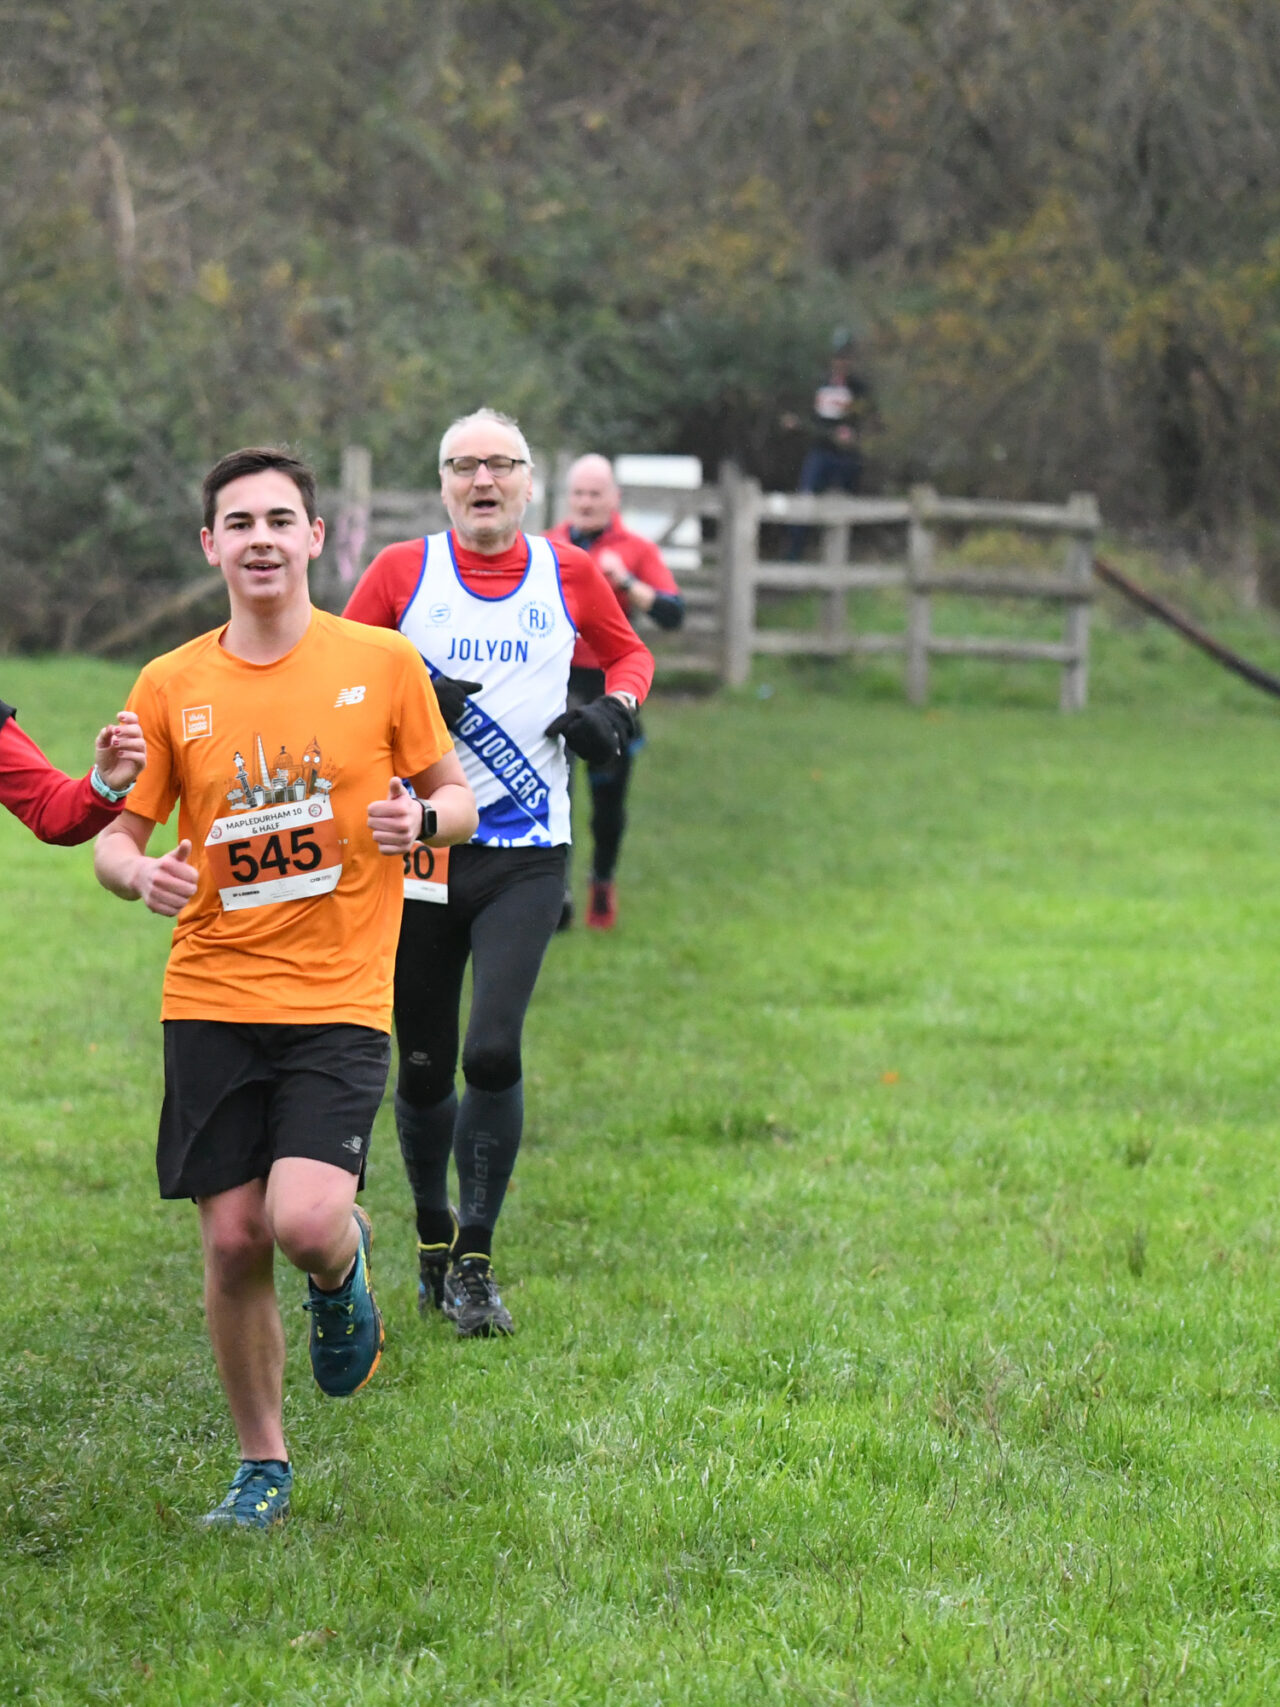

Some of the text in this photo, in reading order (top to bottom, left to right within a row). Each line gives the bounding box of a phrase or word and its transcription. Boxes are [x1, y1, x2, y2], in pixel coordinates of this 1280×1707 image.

[529, 608, 546, 630] RJ
[447, 637, 528, 663] JOLYON
[473, 729, 547, 809] JOGGERS
[226, 807, 302, 830] MAPLEDURHAM 10
[252, 822, 280, 834] & HALF
[228, 827, 322, 882] 545
